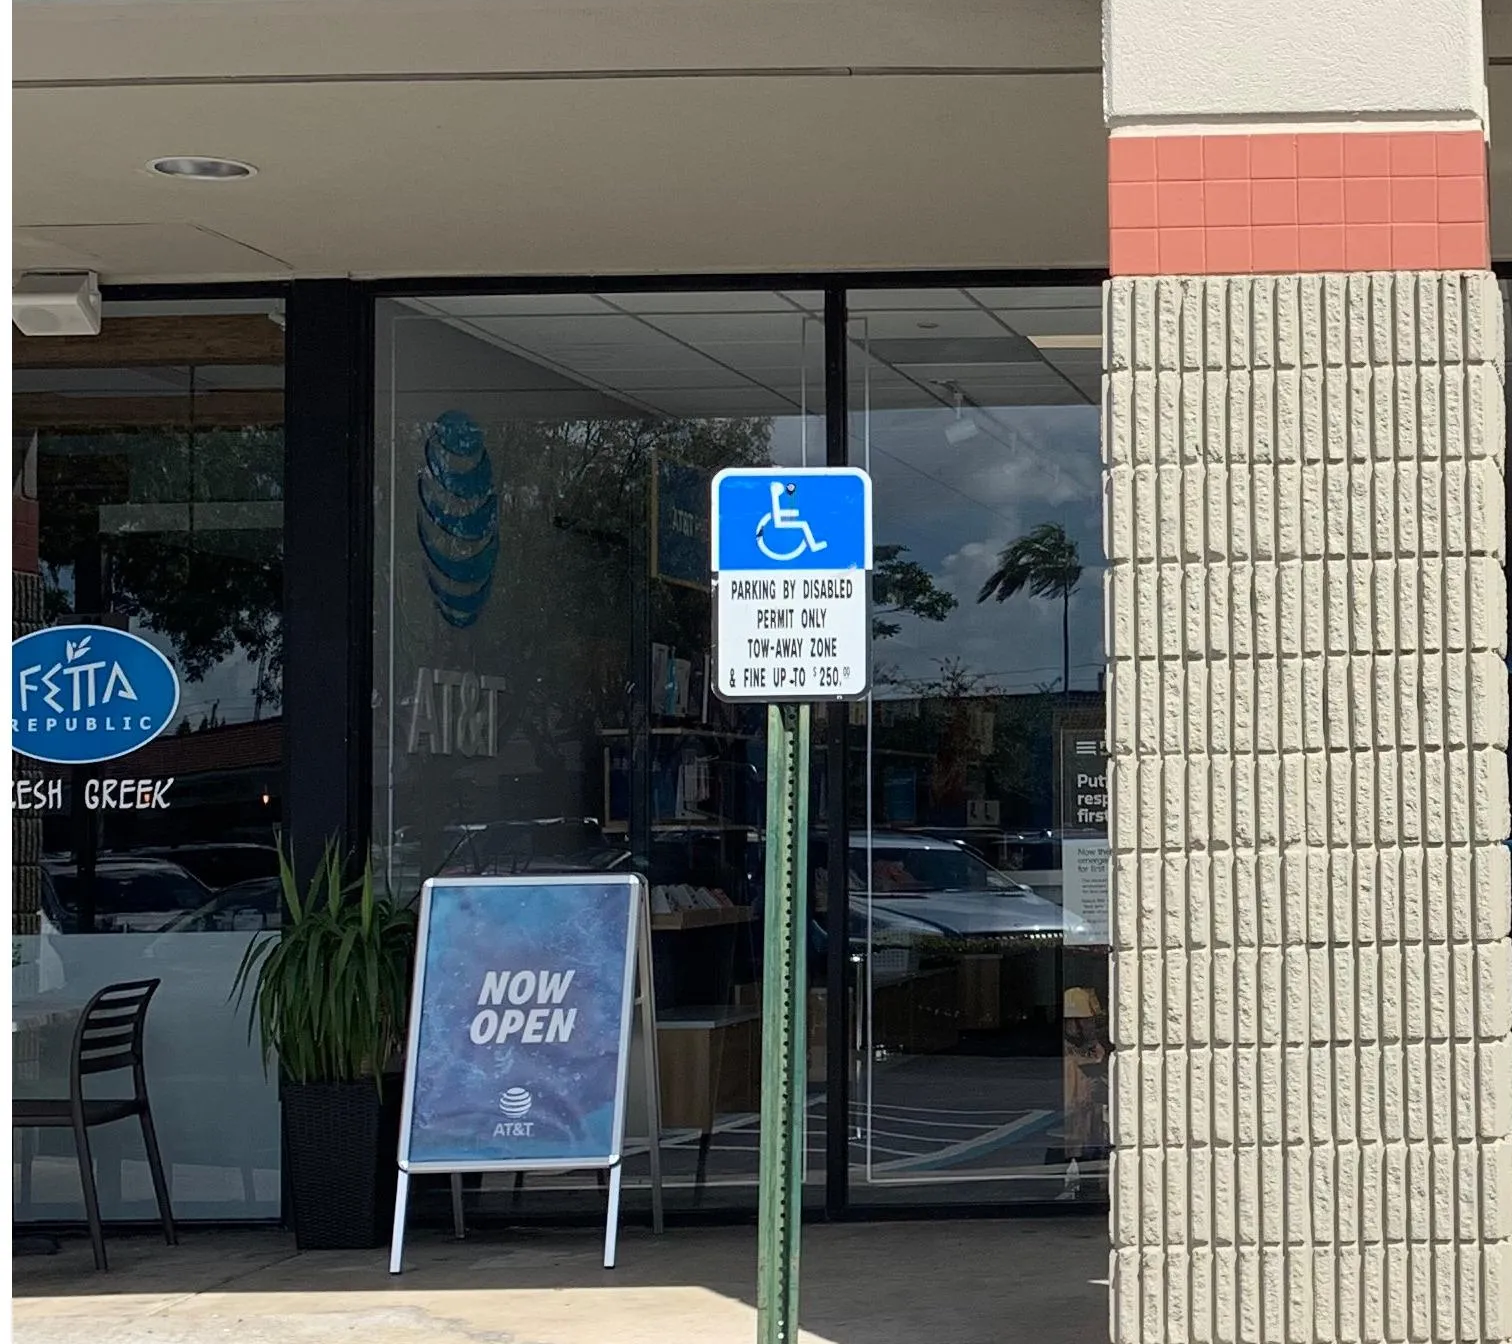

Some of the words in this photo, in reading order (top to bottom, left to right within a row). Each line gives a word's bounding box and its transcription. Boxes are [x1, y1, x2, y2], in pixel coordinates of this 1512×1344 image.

[731, 579, 776, 600] PARKING
[783, 579, 796, 599] BY
[803, 579, 853, 599] DISABLED
[757, 609, 794, 629] PERMIT
[801, 608, 827, 628] ONLY
[747, 638, 803, 659] TOW-AWAY
[810, 637, 837, 657] ZONE
[19, 661, 138, 714] FETTA
[729, 668, 736, 688] &
[743, 668, 766, 687] FINE
[773, 668, 786, 687] UP
[793, 667, 806, 687] TO
[408, 667, 506, 758] AT&T
[12, 716, 151, 732] REPUBLIC
[85, 777, 174, 810] GREEK
[477, 969, 576, 1006] NOW
[470, 1008, 578, 1045] OPEN
[493, 1122, 535, 1137] AT&T
